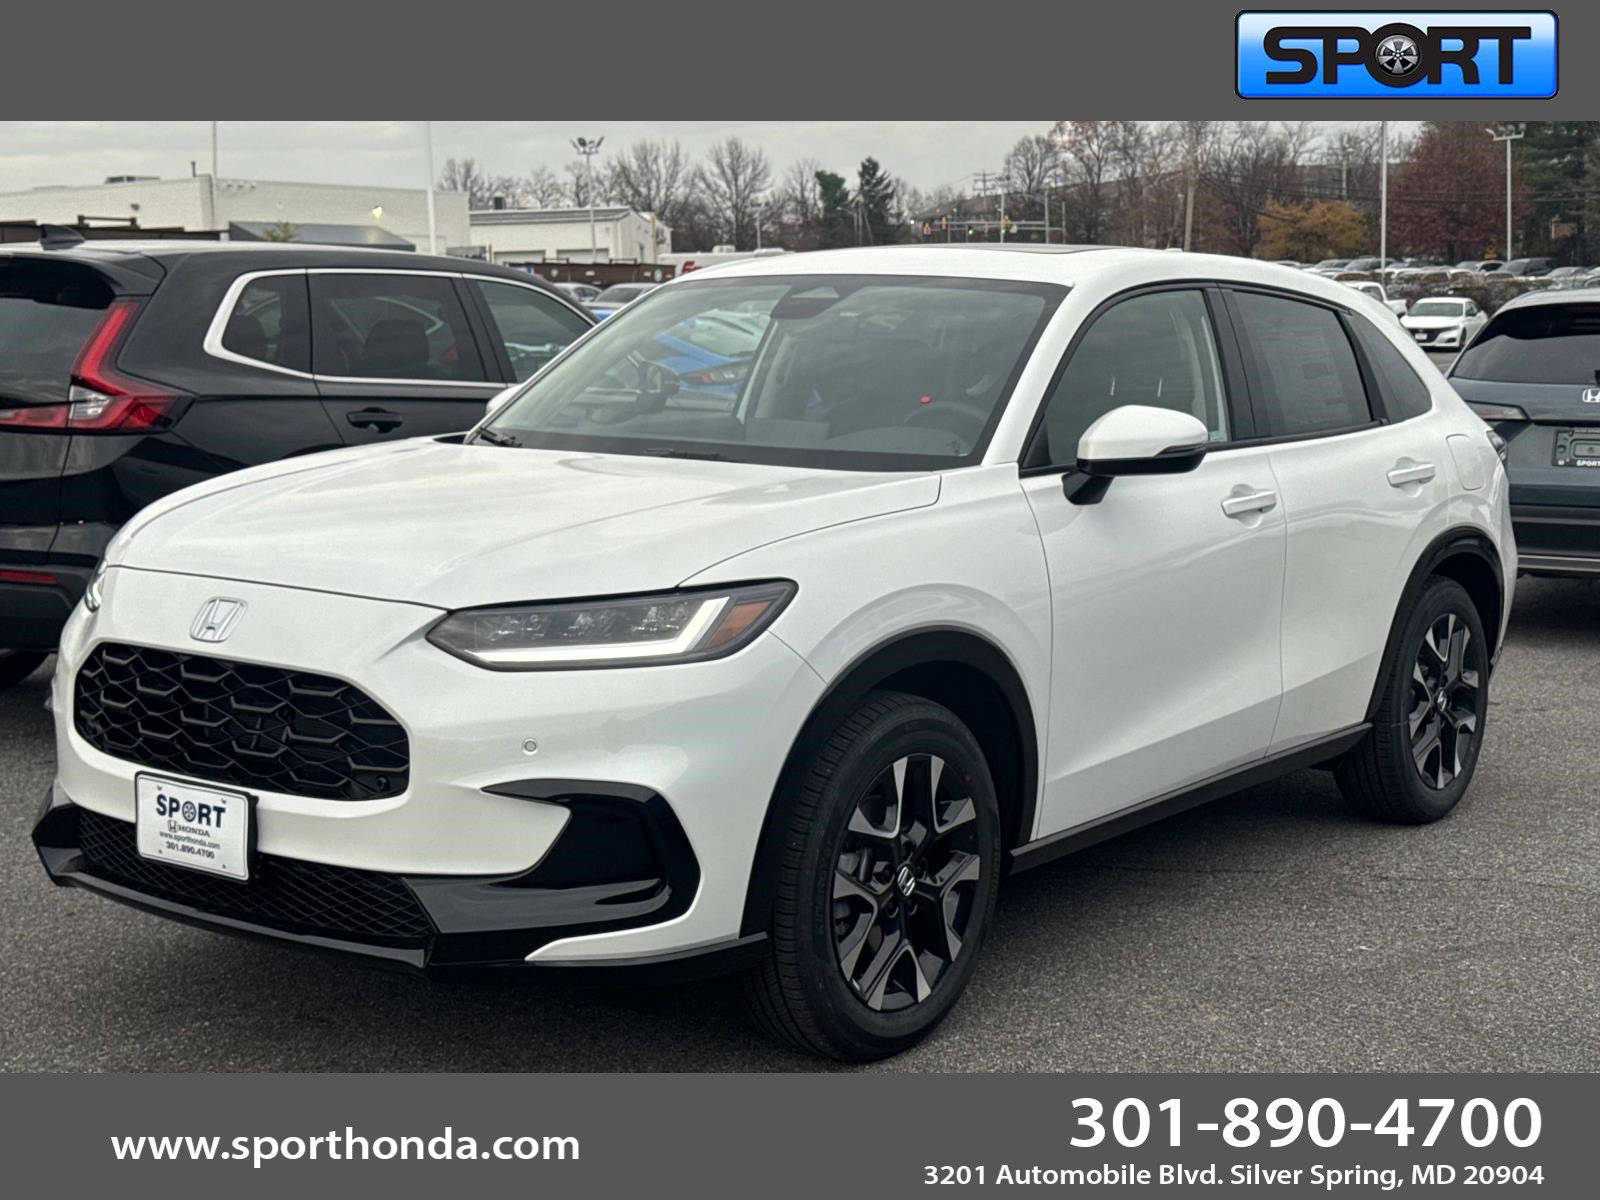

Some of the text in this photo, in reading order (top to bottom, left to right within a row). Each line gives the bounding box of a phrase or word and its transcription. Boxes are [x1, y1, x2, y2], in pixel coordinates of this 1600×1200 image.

[156, 794, 226, 828] SPORT
[178, 825, 211, 837] HONDA
[160, 832, 220, 849] www.sporthonda.com
[166, 841, 215, 859] 301.890.4700
